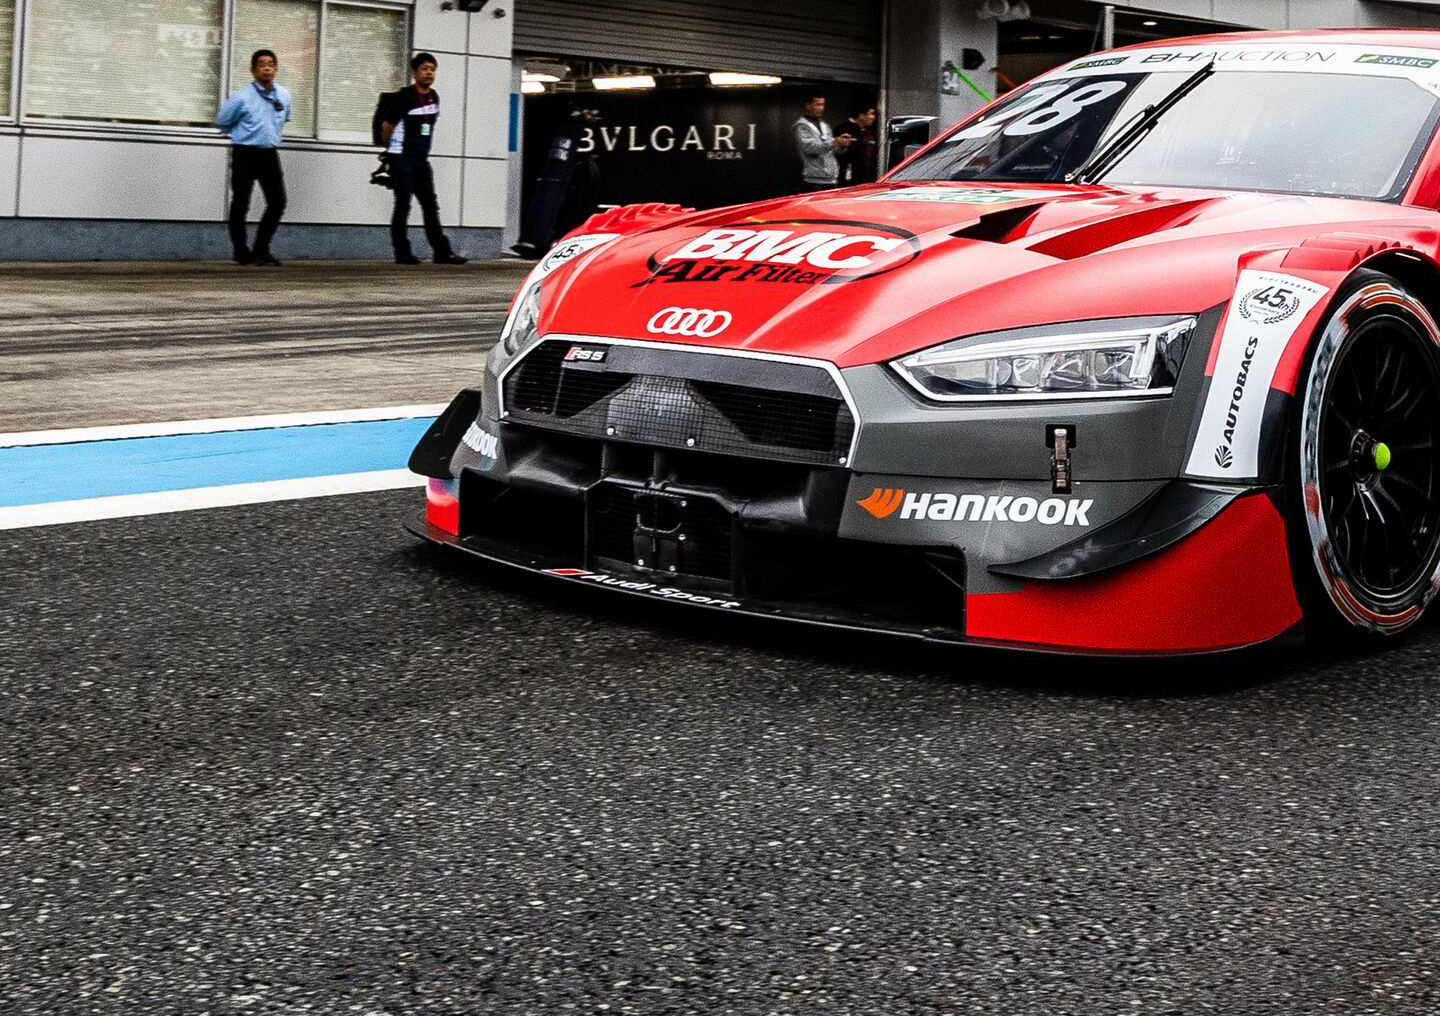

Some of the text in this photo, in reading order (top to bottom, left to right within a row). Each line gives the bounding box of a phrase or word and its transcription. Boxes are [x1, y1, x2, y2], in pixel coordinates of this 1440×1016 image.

[1378, 54, 1435, 69] SMBC
[945, 81, 1127, 143] 28
[661, 229, 910, 269] BMC
[630, 260, 830, 288] Air Filter
[1223, 335, 1259, 446] AUTOBACS
[581, 574, 742, 608] Audi Sport
